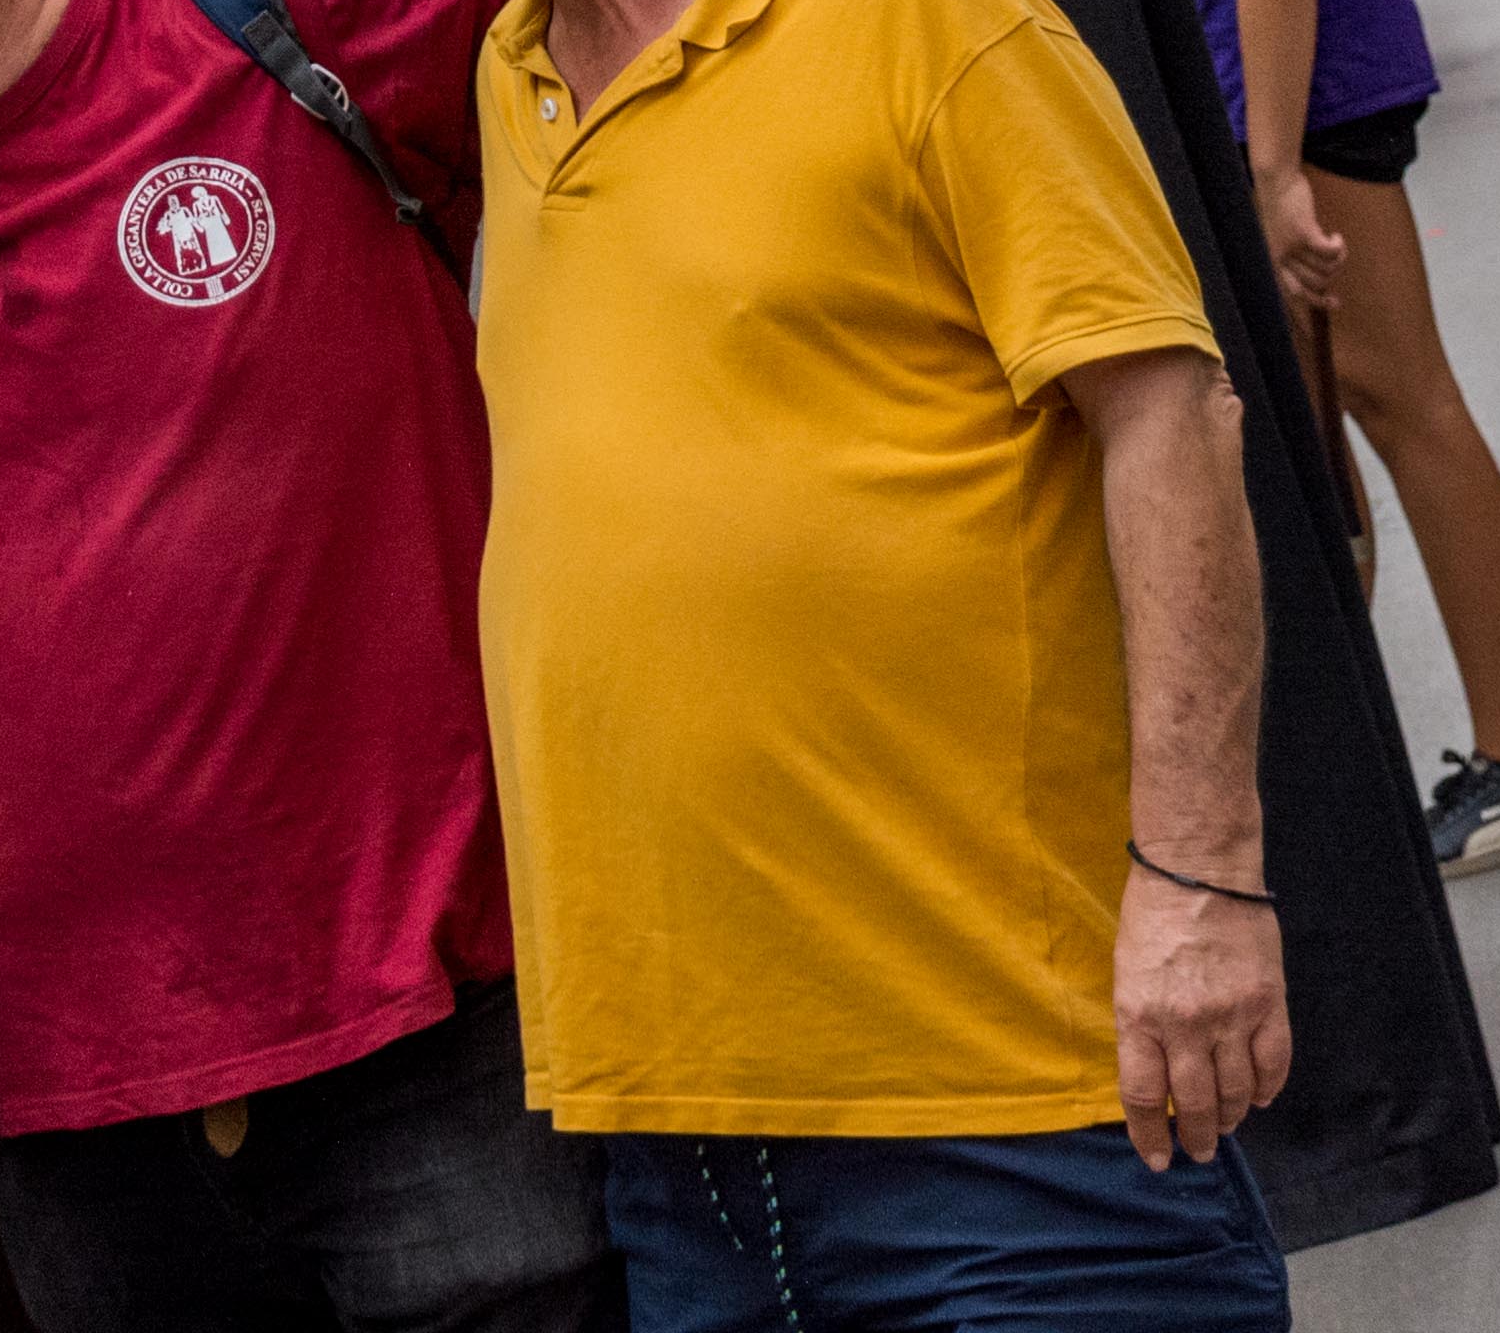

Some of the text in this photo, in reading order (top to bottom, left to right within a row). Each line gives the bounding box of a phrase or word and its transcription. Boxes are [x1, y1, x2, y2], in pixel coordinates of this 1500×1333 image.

[164, 165, 189, 184] DE
[126, 178, 166, 269] GEGANTERA
[232, 219, 268, 283] GERVASI
[143, 267, 194, 298] COLLA
